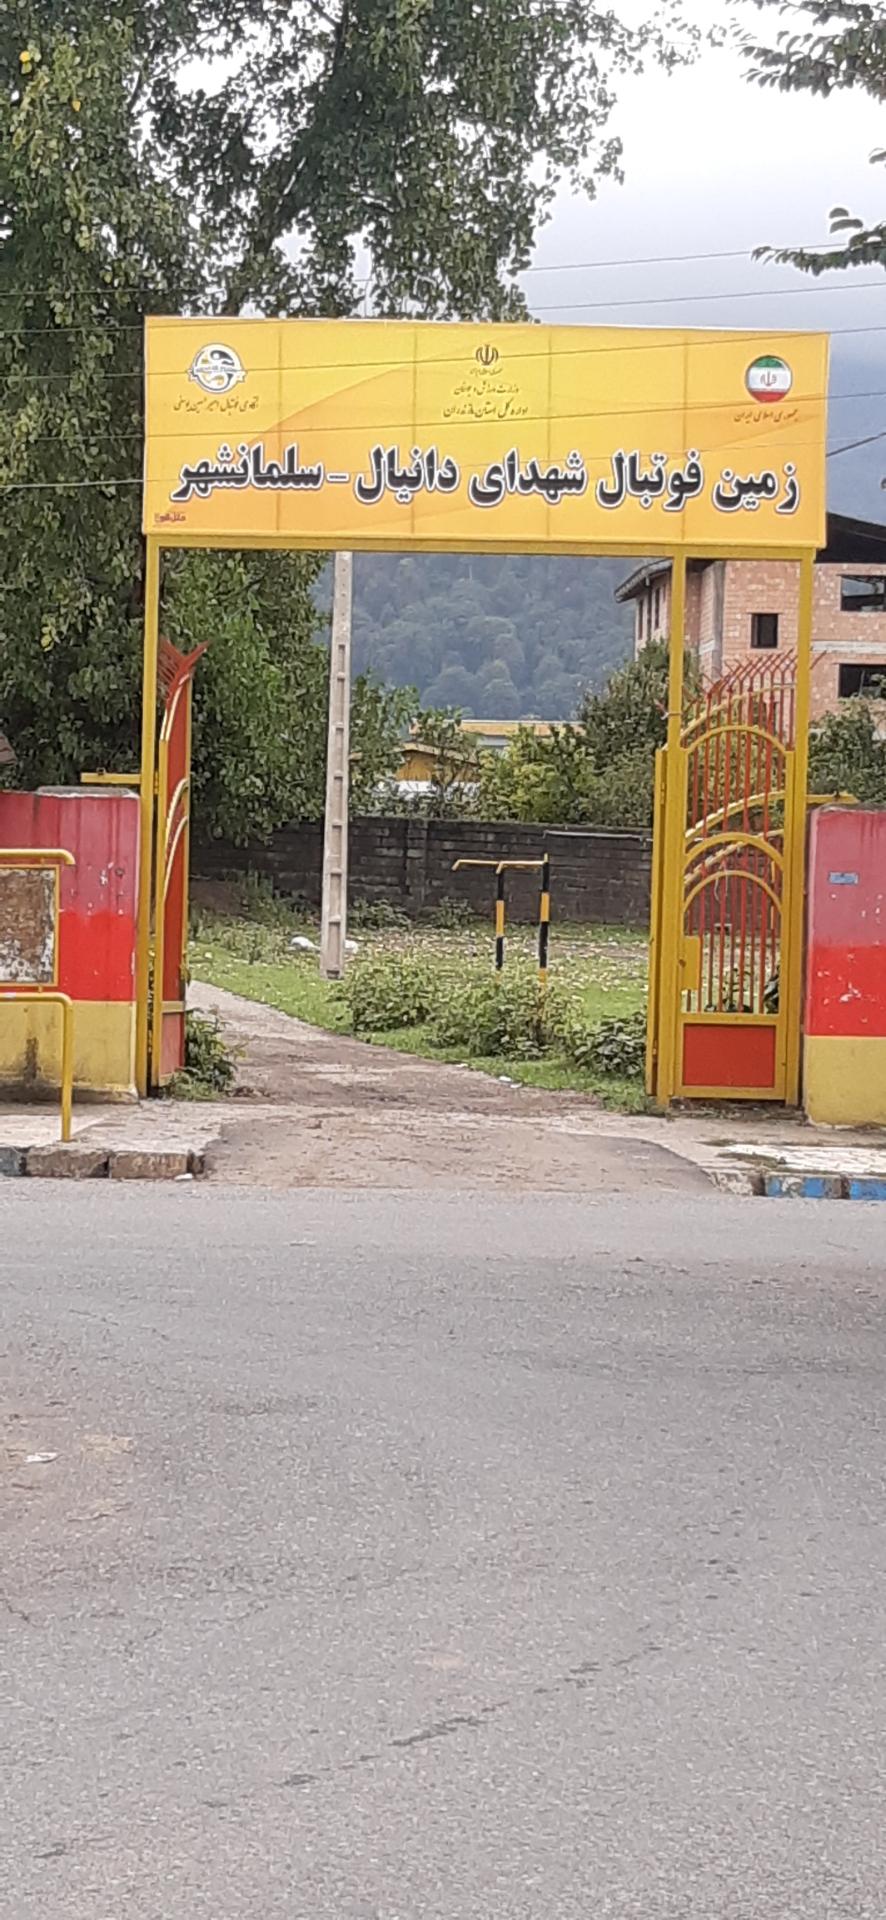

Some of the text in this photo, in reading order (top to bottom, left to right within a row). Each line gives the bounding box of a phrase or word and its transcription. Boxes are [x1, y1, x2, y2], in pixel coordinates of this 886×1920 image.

[220, 396, 240, 416] فوتبال
[475, 401, 497, 418] استان
[497, 397, 514, 418] کل
[510, 406, 528, 415] اداره
[170, 442, 323, 500] سلمانشهر
[354, 444, 459, 504] دانیال
[468, 447, 587, 506] شهدای
[597, 449, 704, 510] فوتبال
[711, 463, 800, 512] زمین
